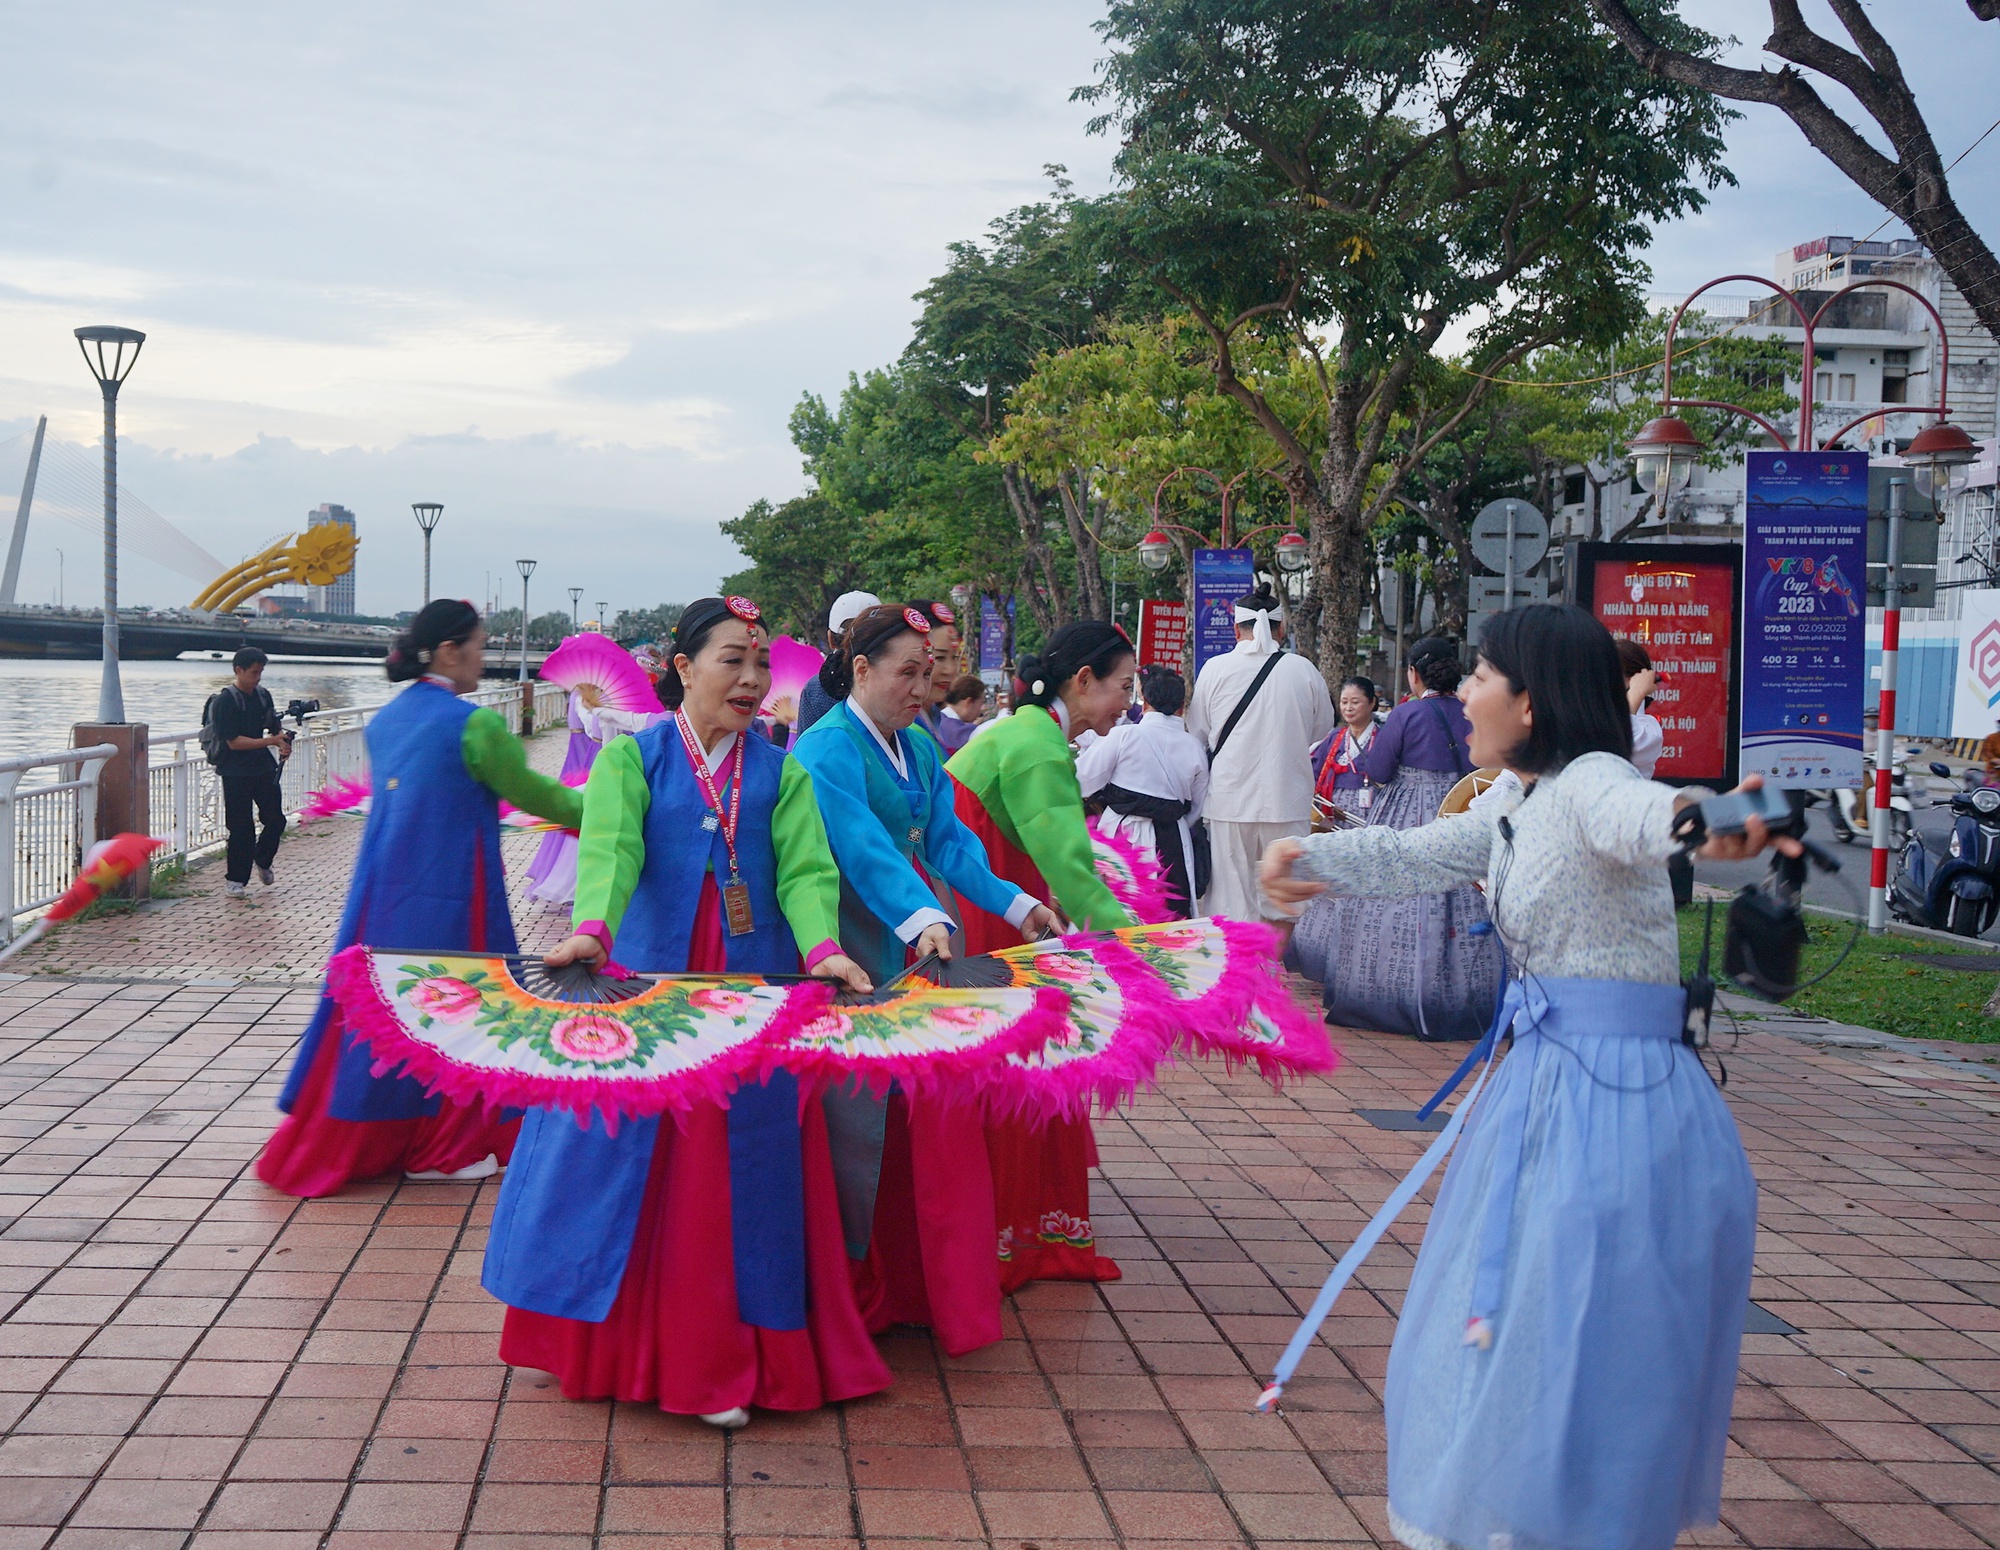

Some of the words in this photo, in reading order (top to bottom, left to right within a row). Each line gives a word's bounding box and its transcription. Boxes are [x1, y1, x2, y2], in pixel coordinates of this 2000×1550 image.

[1767, 557, 1814, 574] VTV8
[1657, 574, 1672, 590] BỘ
[1783, 576, 1808, 595] Cup
[1603, 601, 1633, 616] NHÂN
[1636, 601, 1658, 616] DÂN
[1661, 601, 1676, 616] ĐÀ
[1678, 600, 1709, 617] NẴNG
[1778, 596, 1815, 613] 2023
[1210, 617, 1229, 626] 2023
[1764, 624, 1791, 633] 07:30
[1798, 624, 1847, 633] 02.09.2023
[1654, 629, 1687, 646] QUYẾT
[1689, 631, 1713, 645] TÂM
[1681, 658, 1716, 673] THÀNH
[1761, 655, 1782, 664] 400
[1785, 655, 1798, 664] 22
[1650, 689, 1680, 704] OẠCH
[1661, 716, 1675, 729] XÃ
[1678, 716, 1696, 732] HỘI
[699, 763, 710, 778] KCEA
